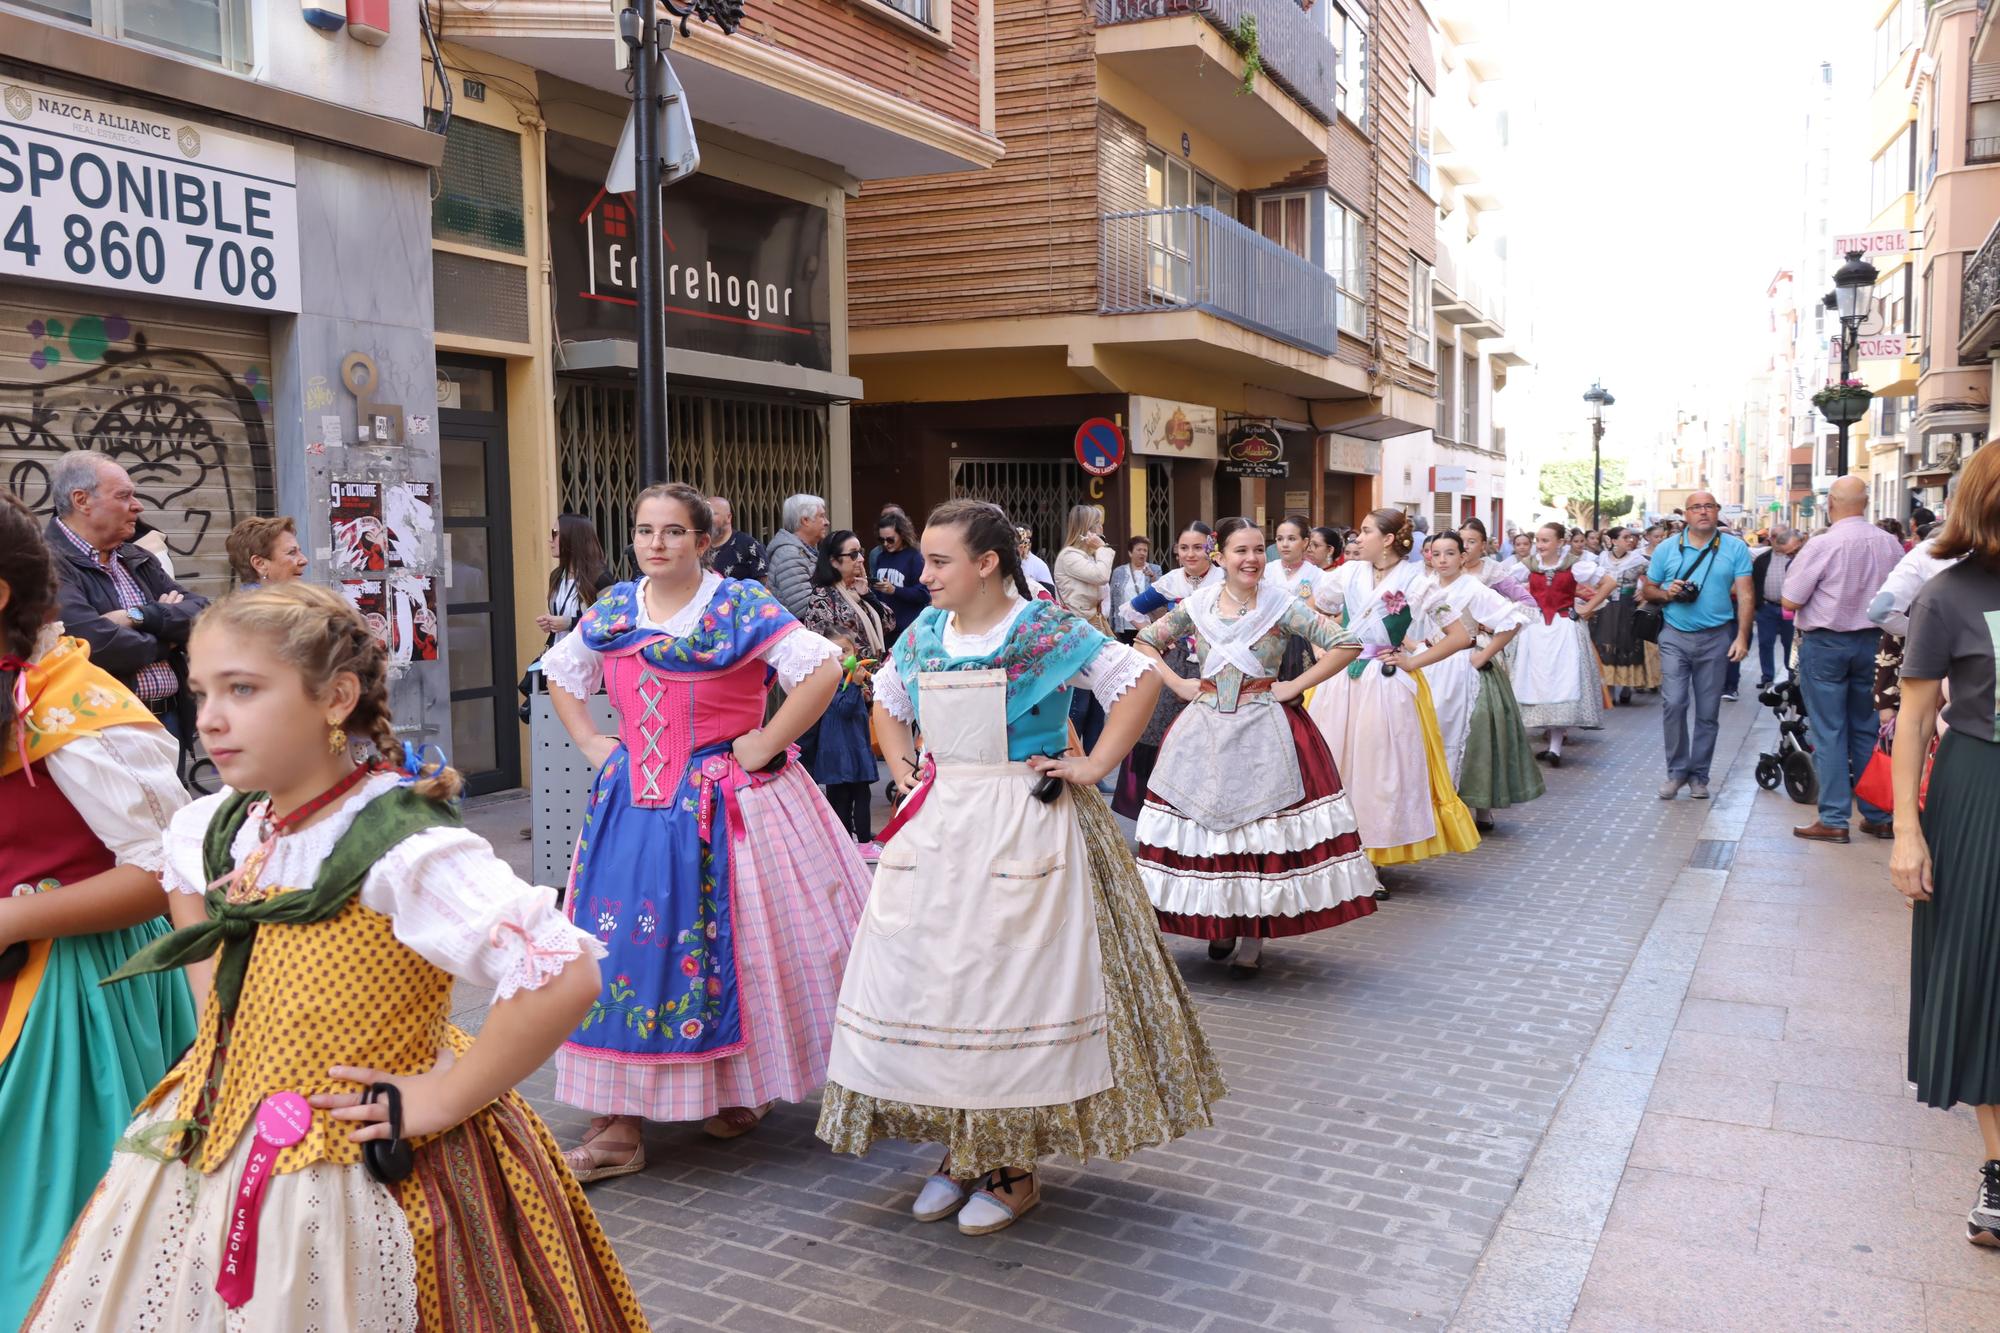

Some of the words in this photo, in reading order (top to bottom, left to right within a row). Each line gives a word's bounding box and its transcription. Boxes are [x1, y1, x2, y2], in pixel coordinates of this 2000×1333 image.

[467, 82, 482, 99] 121
[38, 97, 94, 123] NAZCA
[97, 111, 171, 141] ALLIANCE
[73, 123, 96, 136] REAL
[97, 128, 127, 144] ESTATE
[1836, 234, 1904, 255] MUSICAL
[63, 213, 166, 285] 860
[185, 234, 277, 301] 708
[1833, 339, 1902, 358] PTOLES
[1101, 462, 1118, 474] LADOS
[241, 1152, 267, 1198] NOVA
[225, 1208, 248, 1276] ESCOLA
